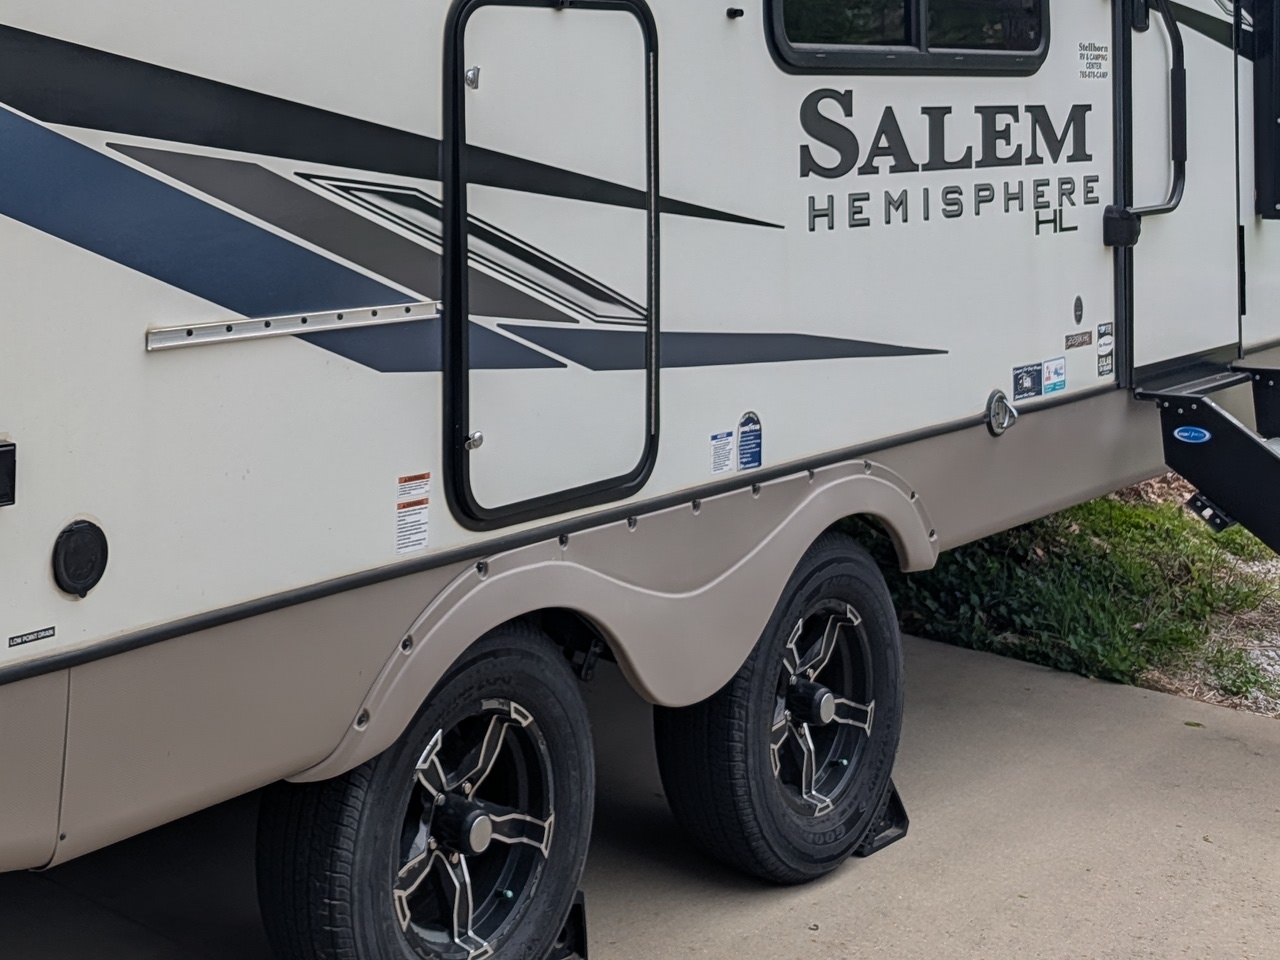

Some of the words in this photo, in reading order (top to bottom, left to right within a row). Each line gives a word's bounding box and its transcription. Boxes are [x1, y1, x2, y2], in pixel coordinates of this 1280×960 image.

[1079, 43, 1108, 52] Stellhorn
[799, 88, 1093, 179] SALEM
[807, 175, 1100, 232] HEMISPHERE
[1034, 208, 1079, 236] HL
[10, 637, 22, 646] LOW
[22, 633, 38, 642] POINT
[38, 628, 54, 638] DRAIN
